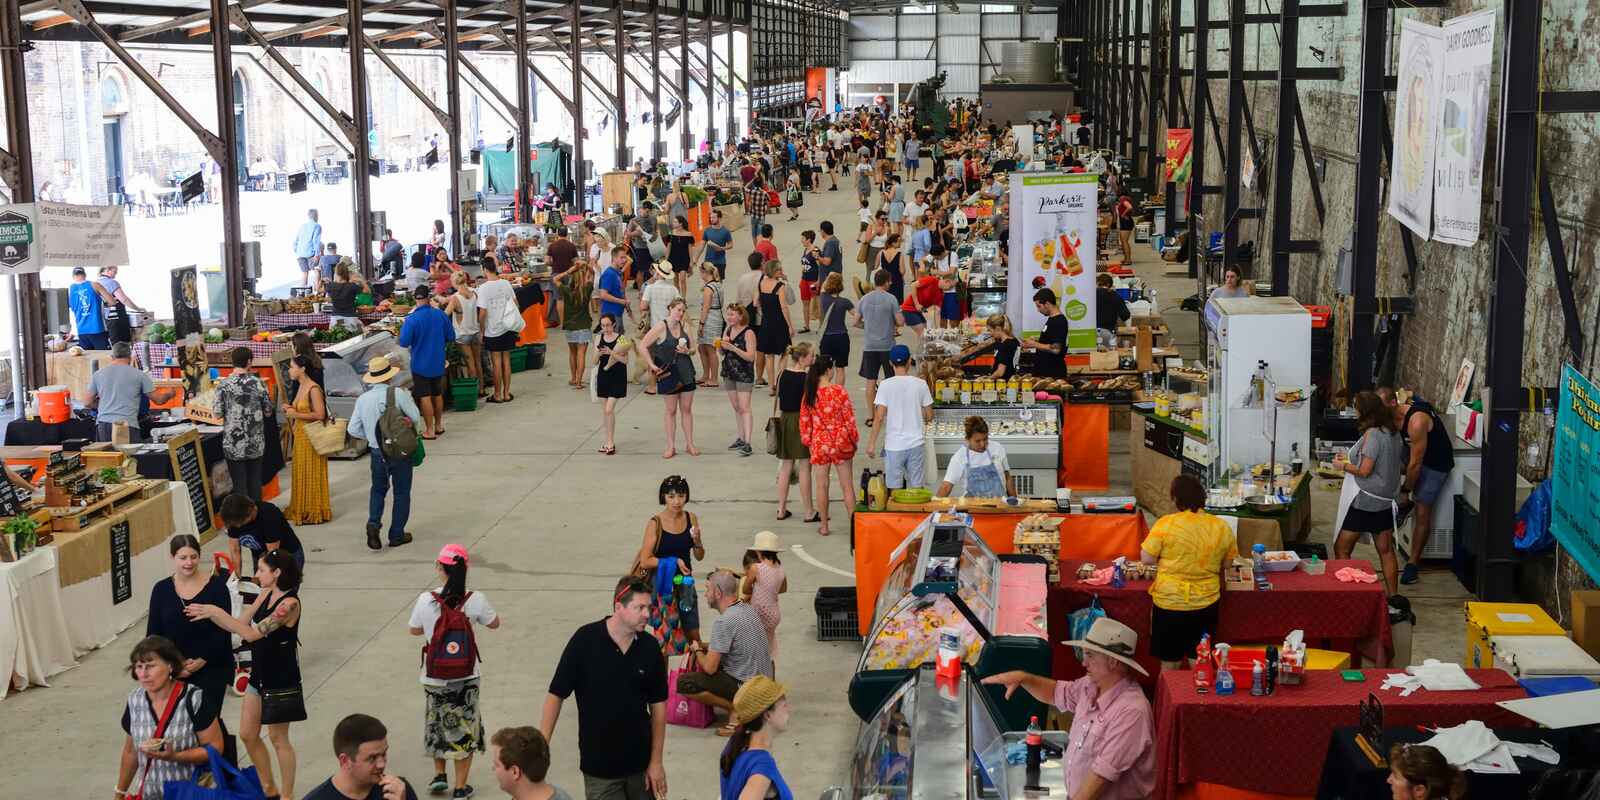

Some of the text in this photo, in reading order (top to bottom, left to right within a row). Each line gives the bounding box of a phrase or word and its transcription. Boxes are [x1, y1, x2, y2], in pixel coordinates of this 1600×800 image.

[1461, 25, 1490, 48] GOODNESS
[1038, 194, 1082, 214] Parker's
[190, 409, 213, 419] PASTA
